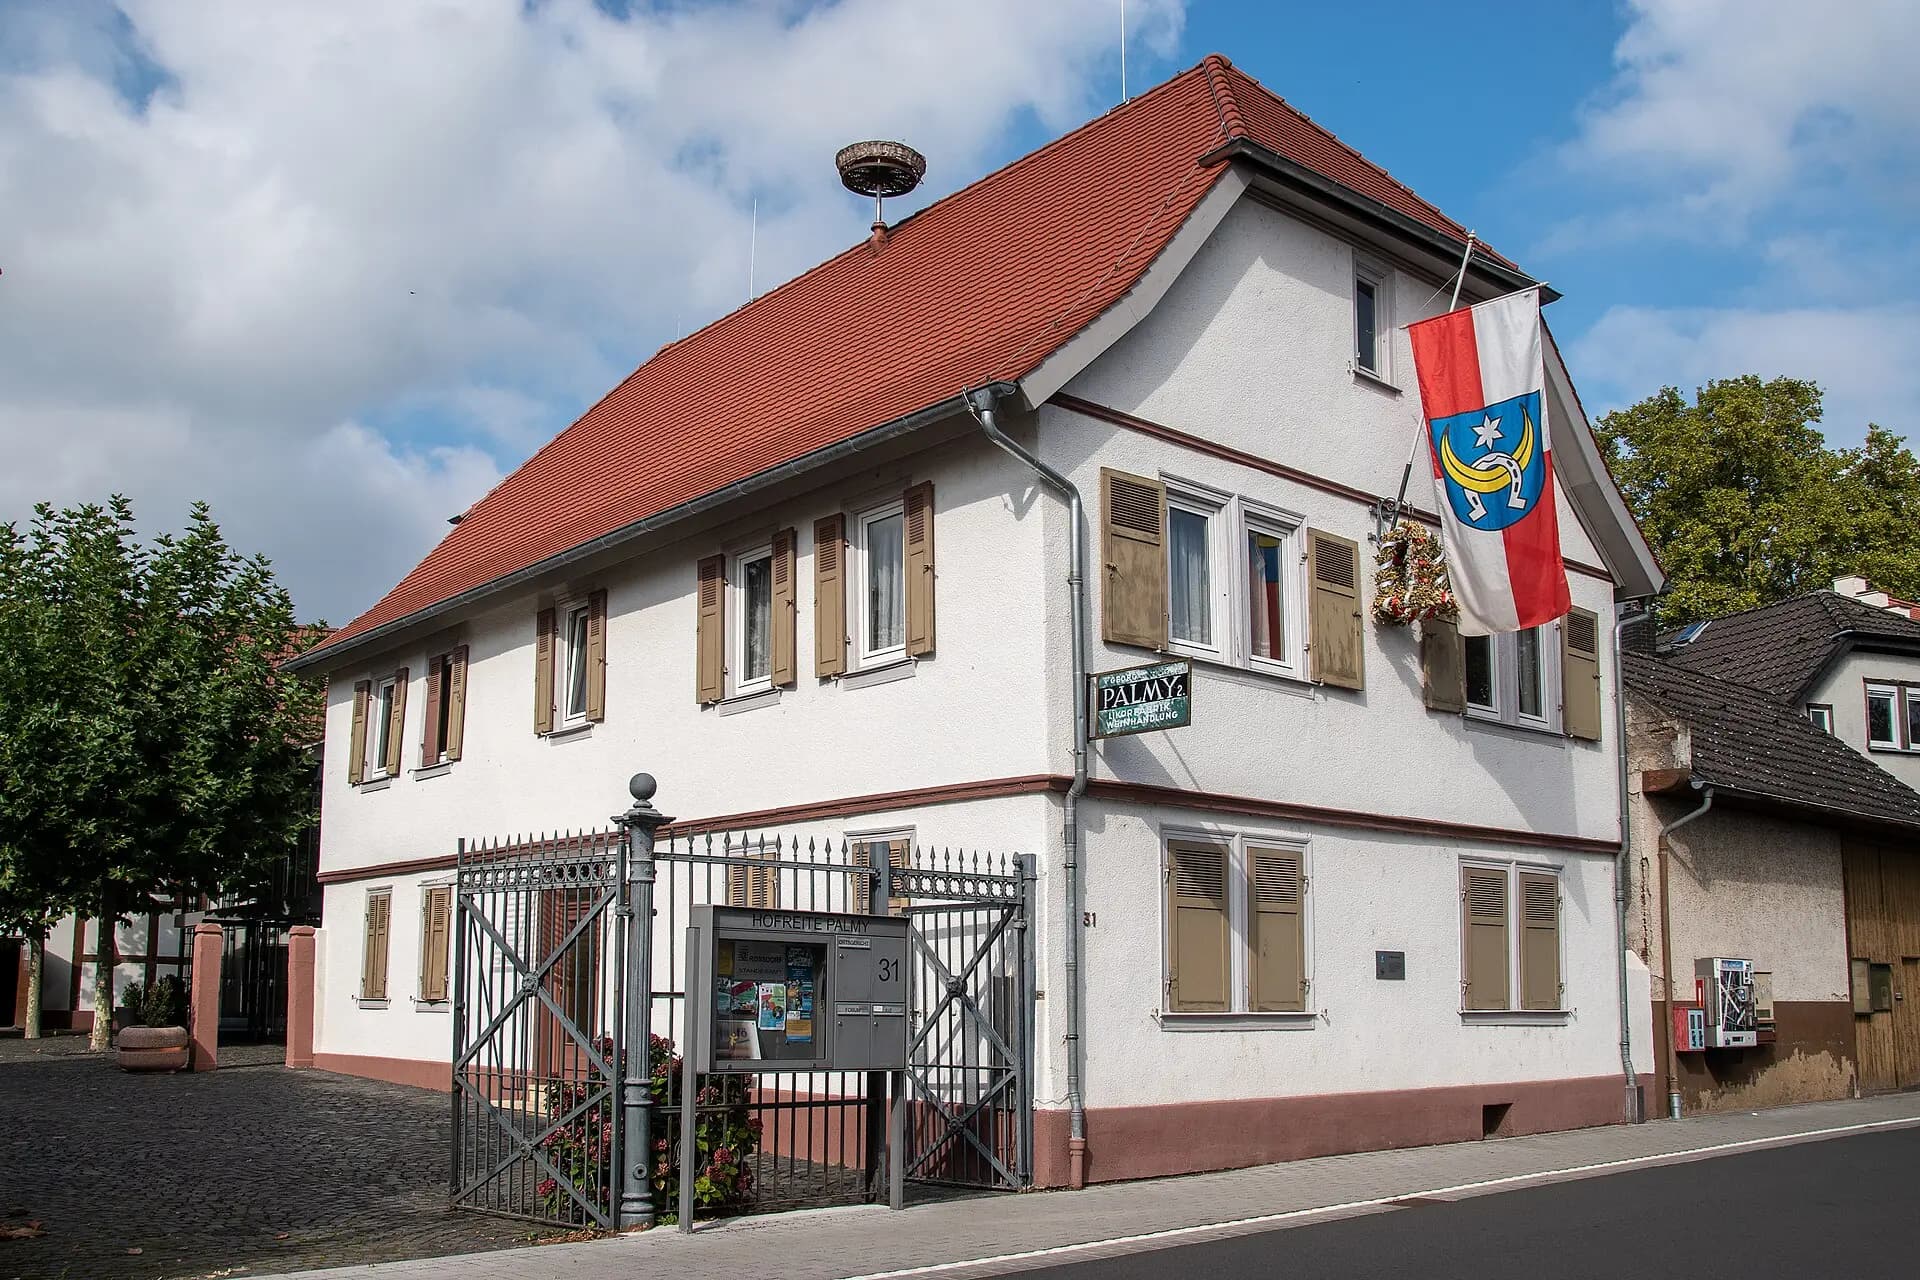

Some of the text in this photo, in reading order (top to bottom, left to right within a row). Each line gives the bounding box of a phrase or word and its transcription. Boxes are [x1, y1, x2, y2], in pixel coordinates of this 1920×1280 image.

[1103, 676, 1181, 709] PALMY
[1106, 711, 1178, 729] WEINHANDLUNG
[752, 913, 870, 933] HOFREITE PALMY
[1083, 911, 1096, 928] 31
[878, 958, 899, 982] 31
